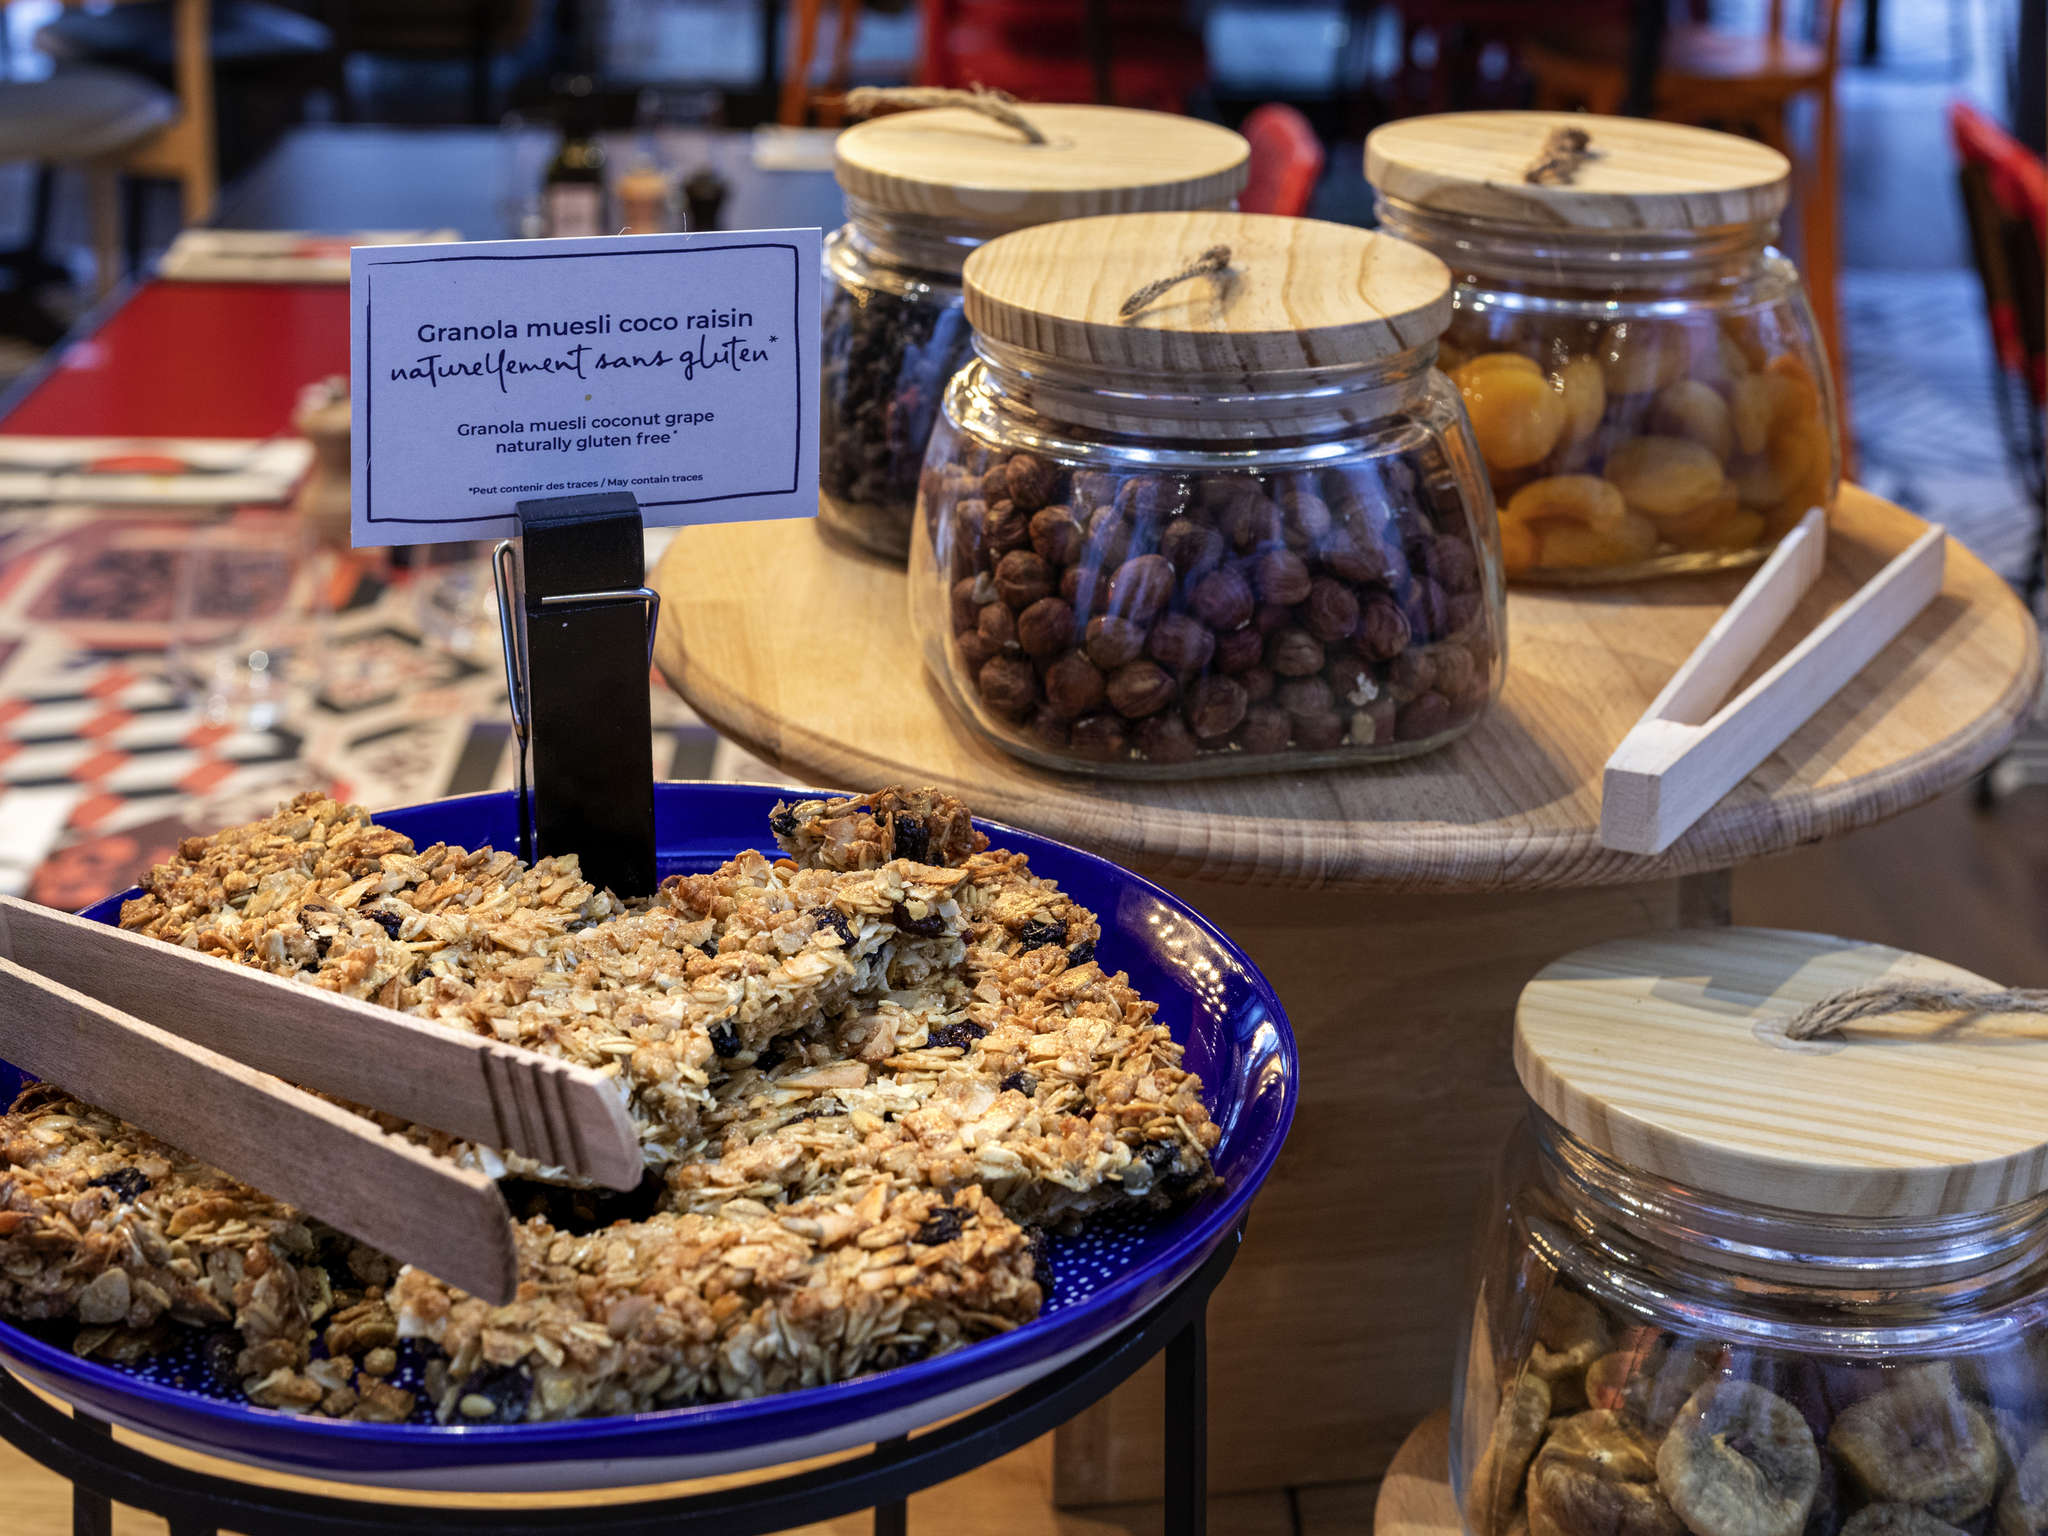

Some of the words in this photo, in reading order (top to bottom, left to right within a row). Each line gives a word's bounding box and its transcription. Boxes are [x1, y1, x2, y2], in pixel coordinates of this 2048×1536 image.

[417, 319, 518, 343] Granola
[527, 313, 611, 338] muesli
[619, 316, 679, 333] coco
[687, 307, 753, 330] raisin
[391, 344, 592, 394] naturellement
[595, 350, 674, 370] sans
[457, 420, 525, 437] Granola
[530, 415, 587, 433] muesli
[591, 413, 661, 429] coconut
[665, 411, 715, 427] grape
[496, 436, 573, 454] naturally
[576, 435, 632, 452] gluten
[499, 482, 544, 494] contenir
[545, 481, 565, 491] des
[566, 480, 599, 489] traces
[607, 478, 629, 488] May
[630, 475, 670, 486] contain
[671, 473, 704, 483] traces
